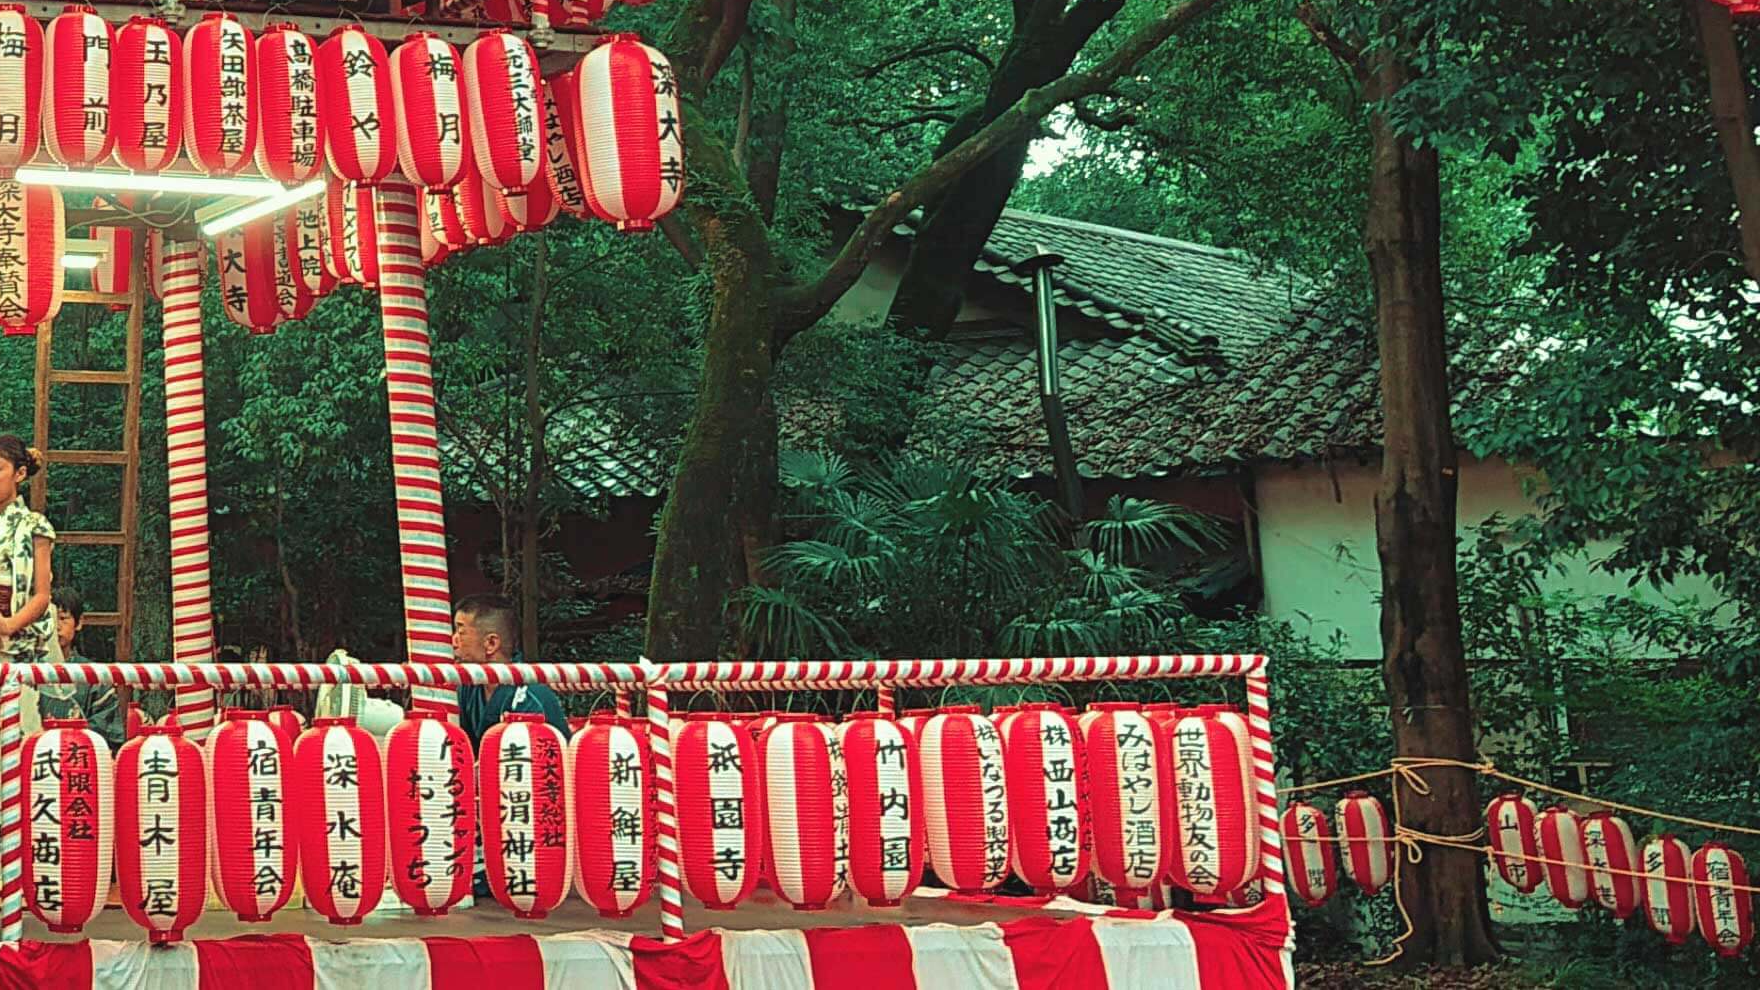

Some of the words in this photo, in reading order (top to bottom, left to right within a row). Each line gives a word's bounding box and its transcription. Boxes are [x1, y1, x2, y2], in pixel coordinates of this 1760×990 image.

[82, 33, 111, 135] 門前
[143, 40, 170, 149] 玉乃屋
[221, 29, 248, 154] 矢田部茶屋
[342, 49, 380, 140] 鈴や
[426, 52, 461, 145] 梅月
[650, 60, 685, 195] 深大寺
[223, 232, 249, 314] 大寺
[297, 210, 323, 277] 池上院
[30, 751, 64, 913] 武久商店
[64, 741, 95, 841] 有限会社
[139, 750, 178, 917] 青木屋
[247, 739, 284, 897] 宿青年会
[324, 752, 362, 900] 深水庵
[406, 768, 436, 890] おうち
[498, 743, 538, 898] 青渭神社
[608, 753, 642, 893] 新鮮屋
[707, 742, 746, 881] 祇園寺
[876, 738, 910, 872] 竹内園
[1117, 723, 1157, 880] みはやし酒店
[1175, 727, 1221, 887] 世界動物友の会
